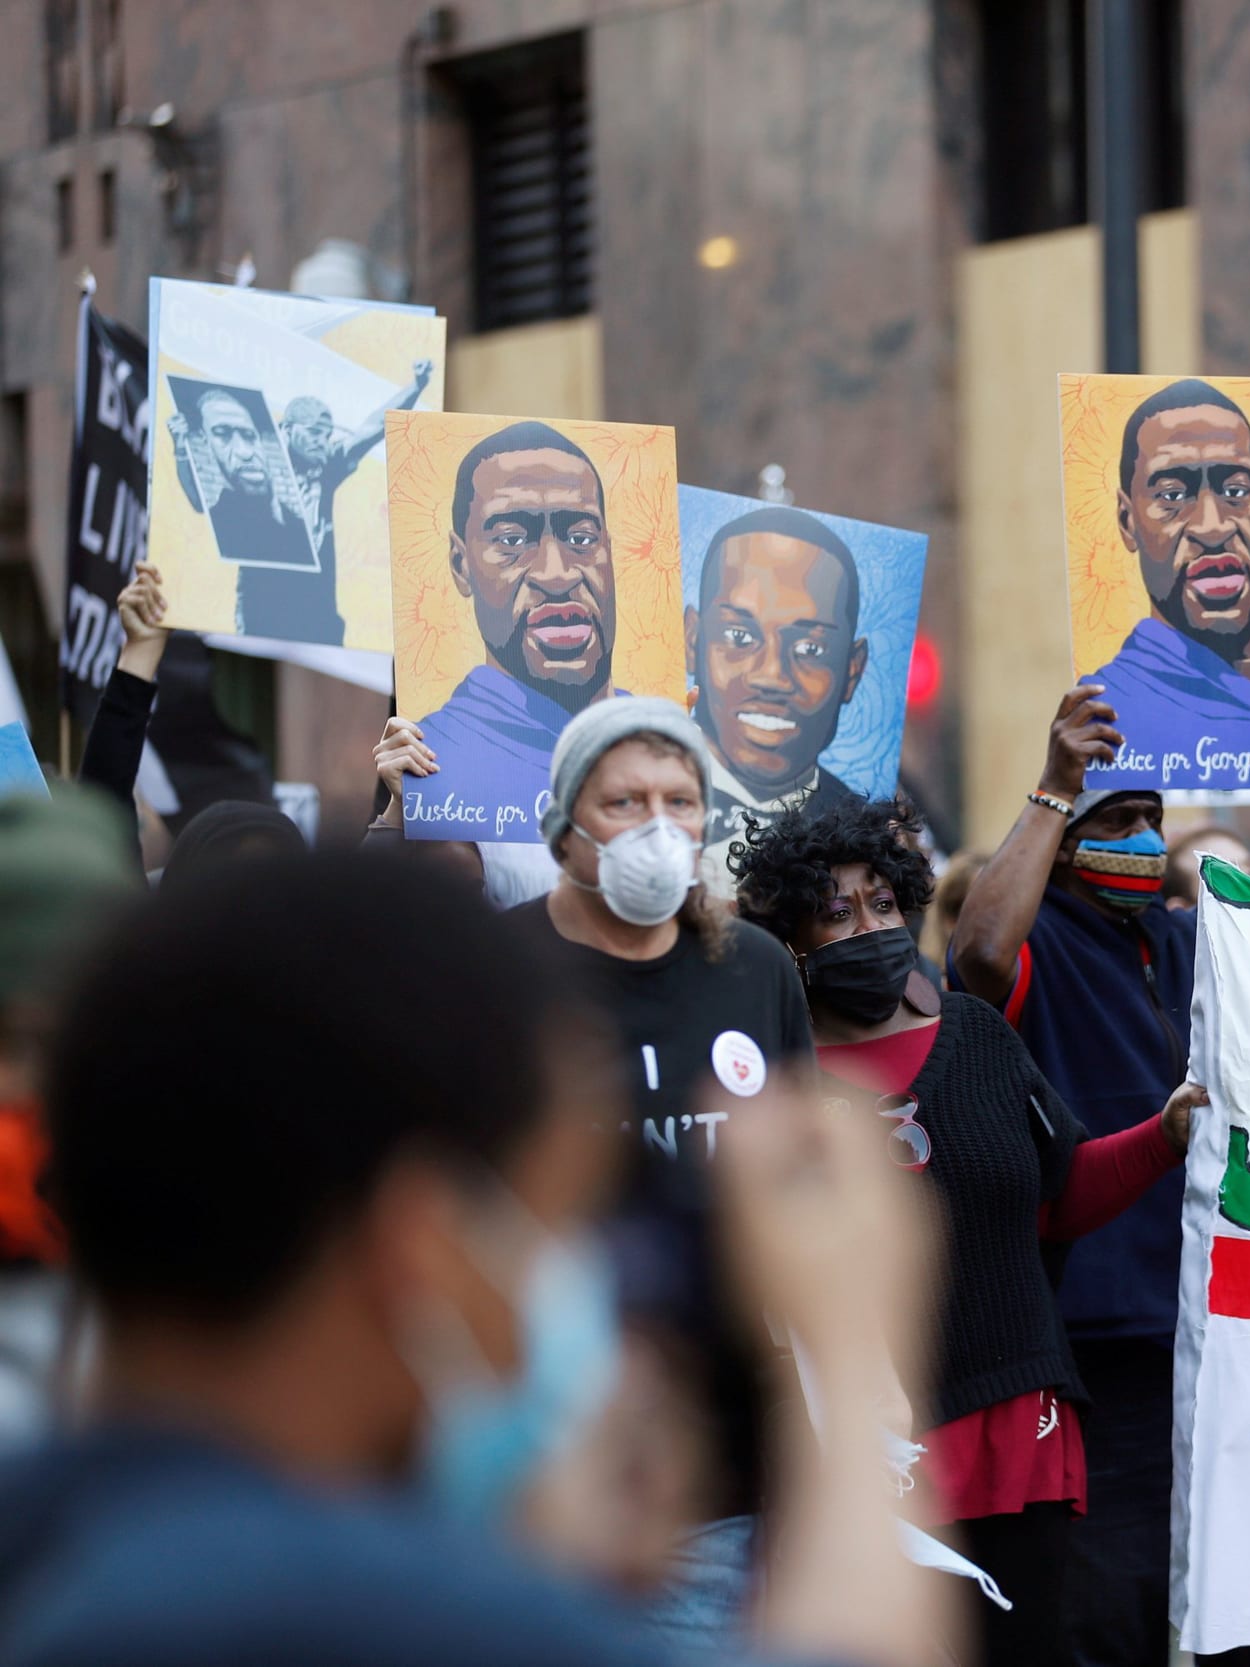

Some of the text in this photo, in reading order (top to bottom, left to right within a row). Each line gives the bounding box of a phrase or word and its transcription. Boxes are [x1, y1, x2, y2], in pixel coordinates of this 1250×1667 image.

[1162, 752, 1191, 783] for
[403, 791, 488, 823] Justice
[495, 804, 528, 837] for
